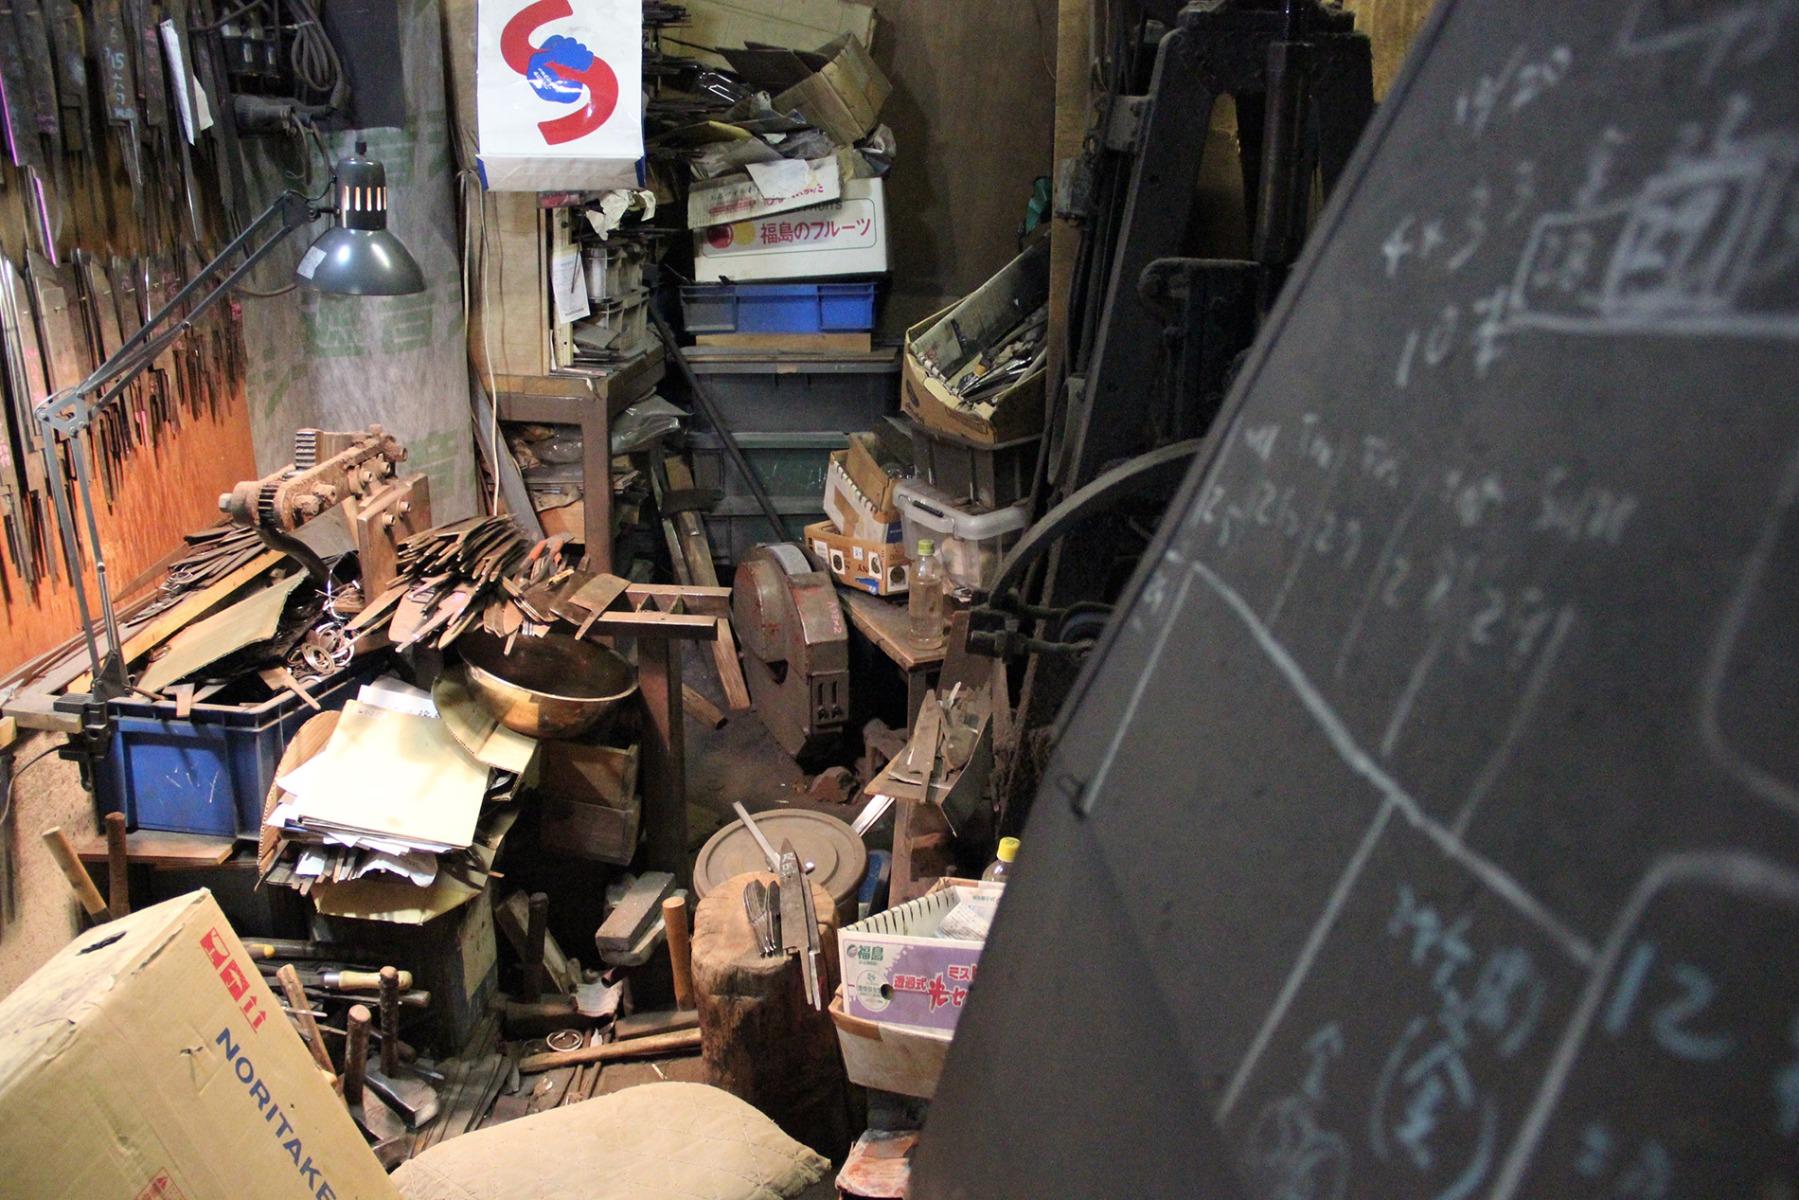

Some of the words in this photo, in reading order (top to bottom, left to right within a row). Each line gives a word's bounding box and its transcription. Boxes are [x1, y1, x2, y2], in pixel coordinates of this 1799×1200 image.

[761, 218, 871, 245] 福島のフルーツ
[857, 945, 884, 962] 福島
[948, 965, 977, 980] ミス
